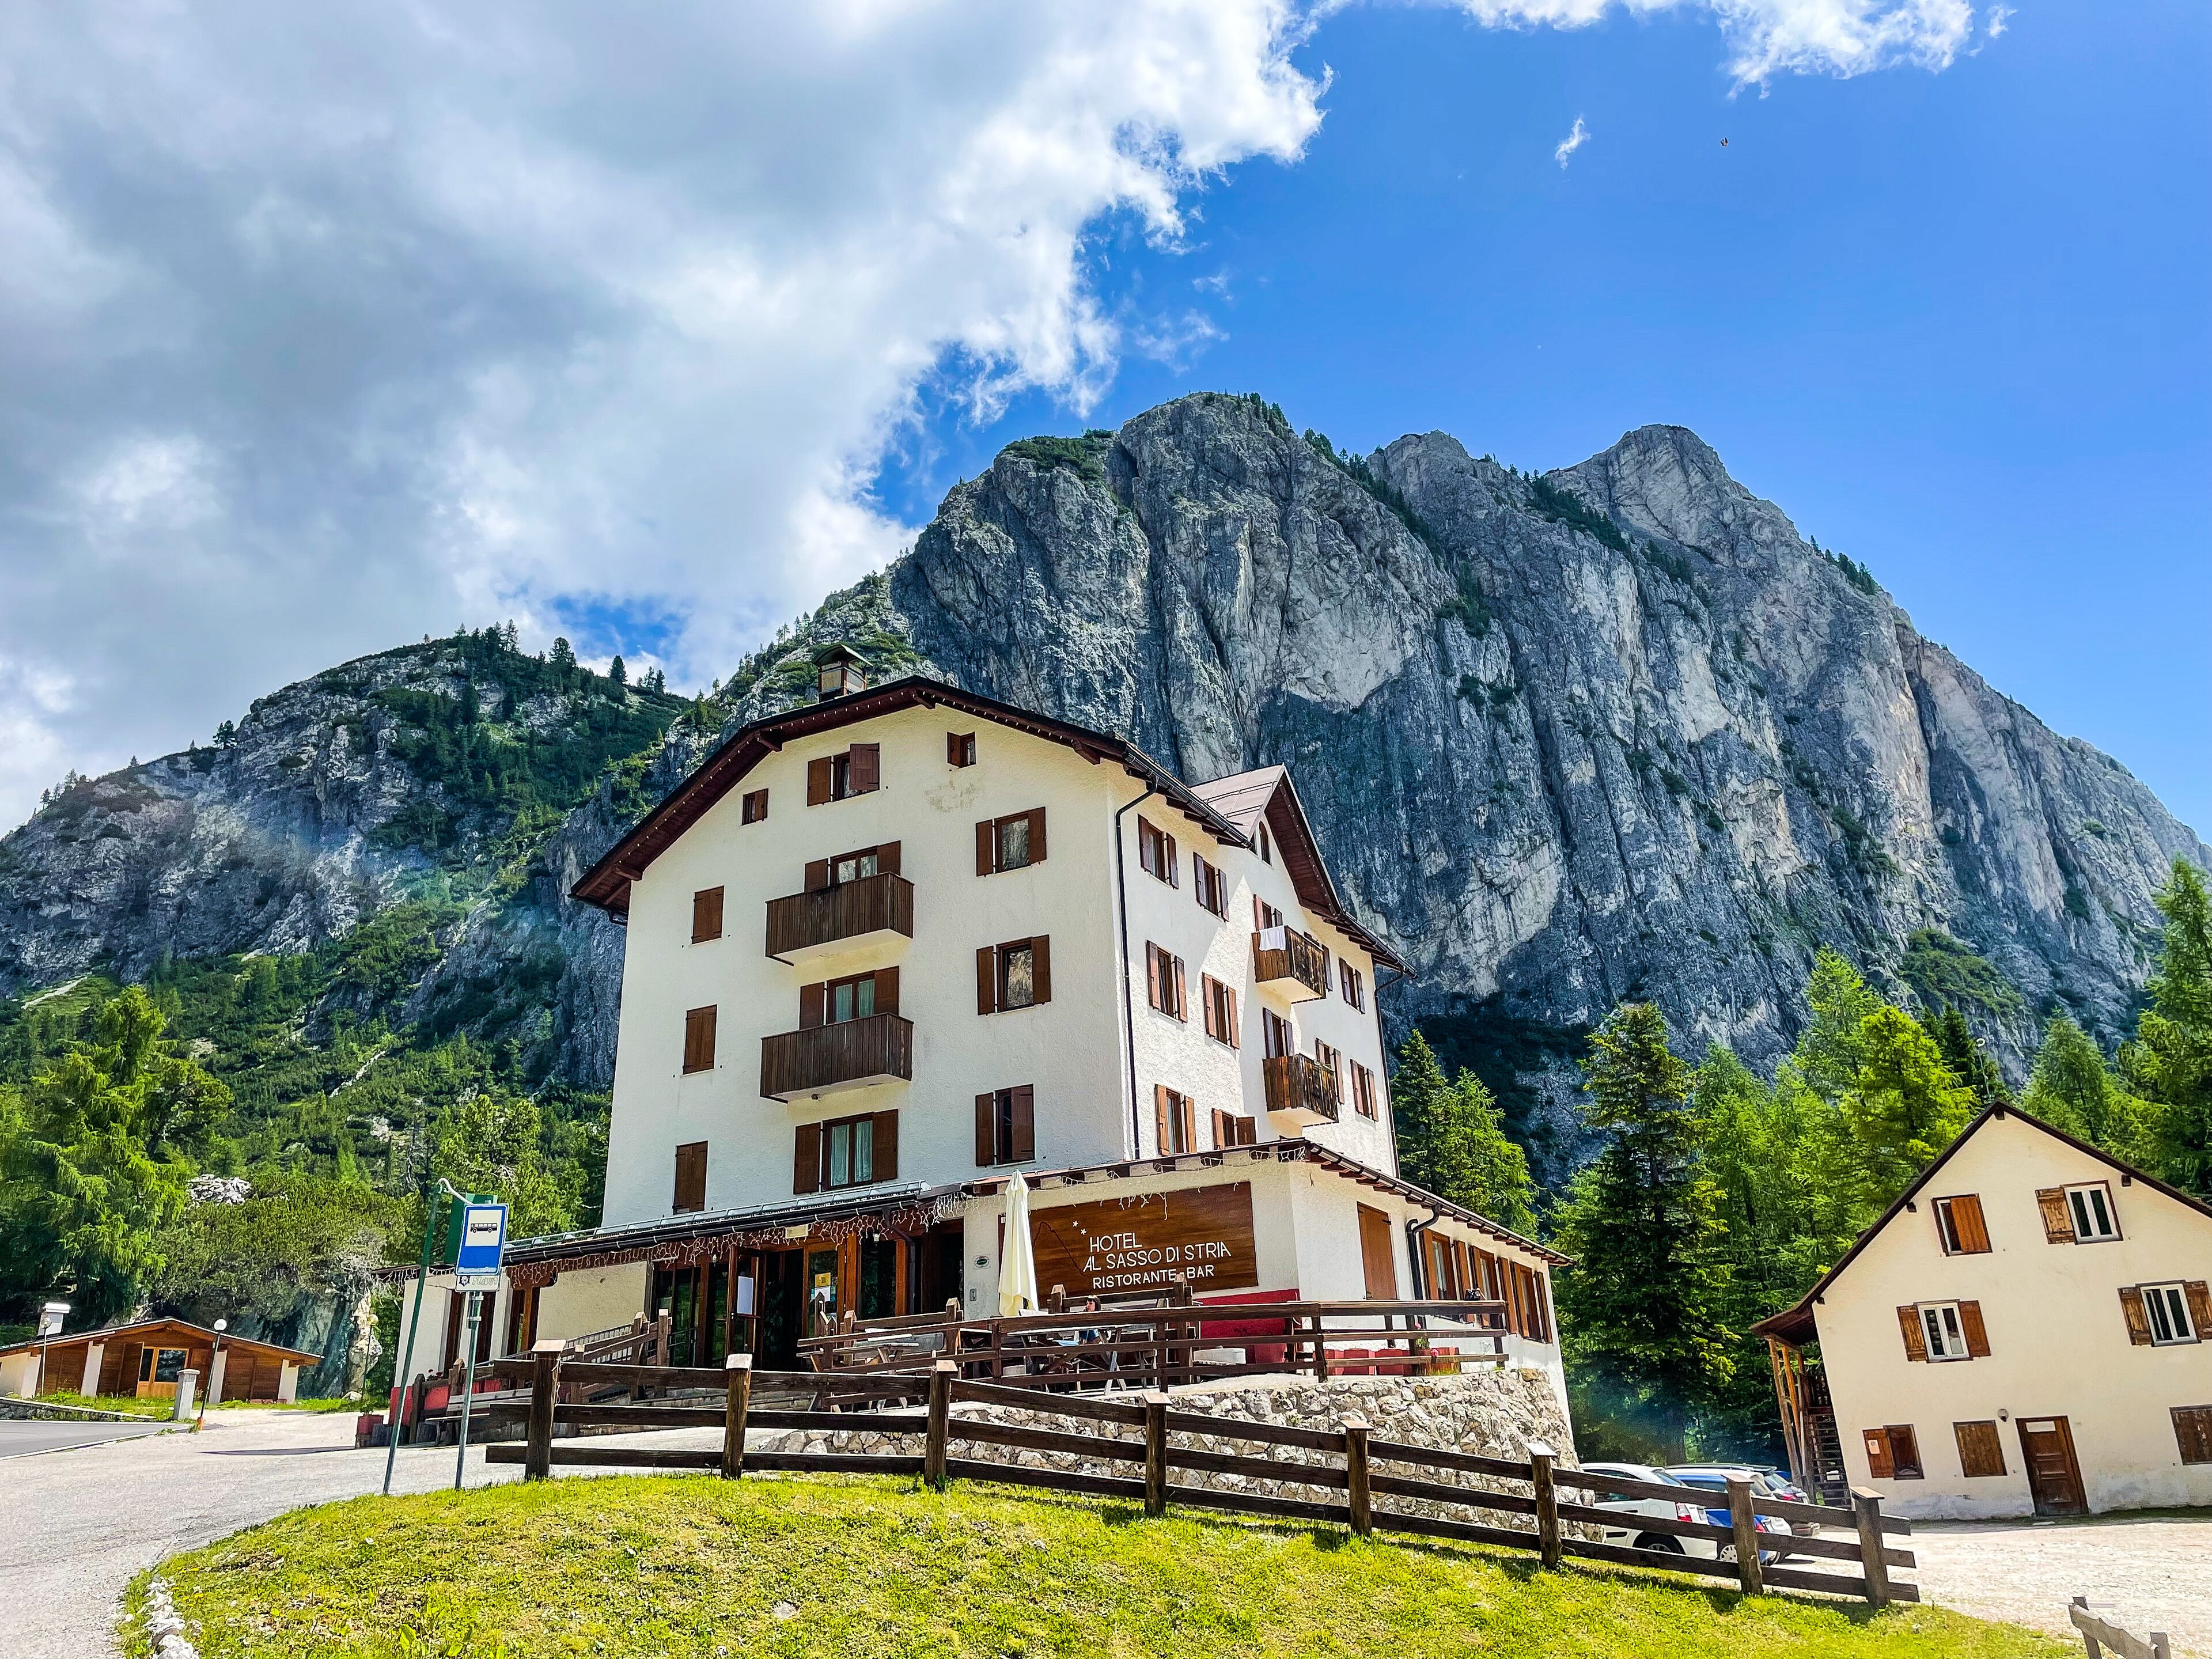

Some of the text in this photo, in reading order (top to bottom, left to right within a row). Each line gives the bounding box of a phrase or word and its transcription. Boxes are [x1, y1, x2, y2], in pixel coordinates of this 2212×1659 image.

[1089, 1232, 1143, 1253] HOTEL
[1083, 1241, 1232, 1272] AL SASSO DI STRIA
